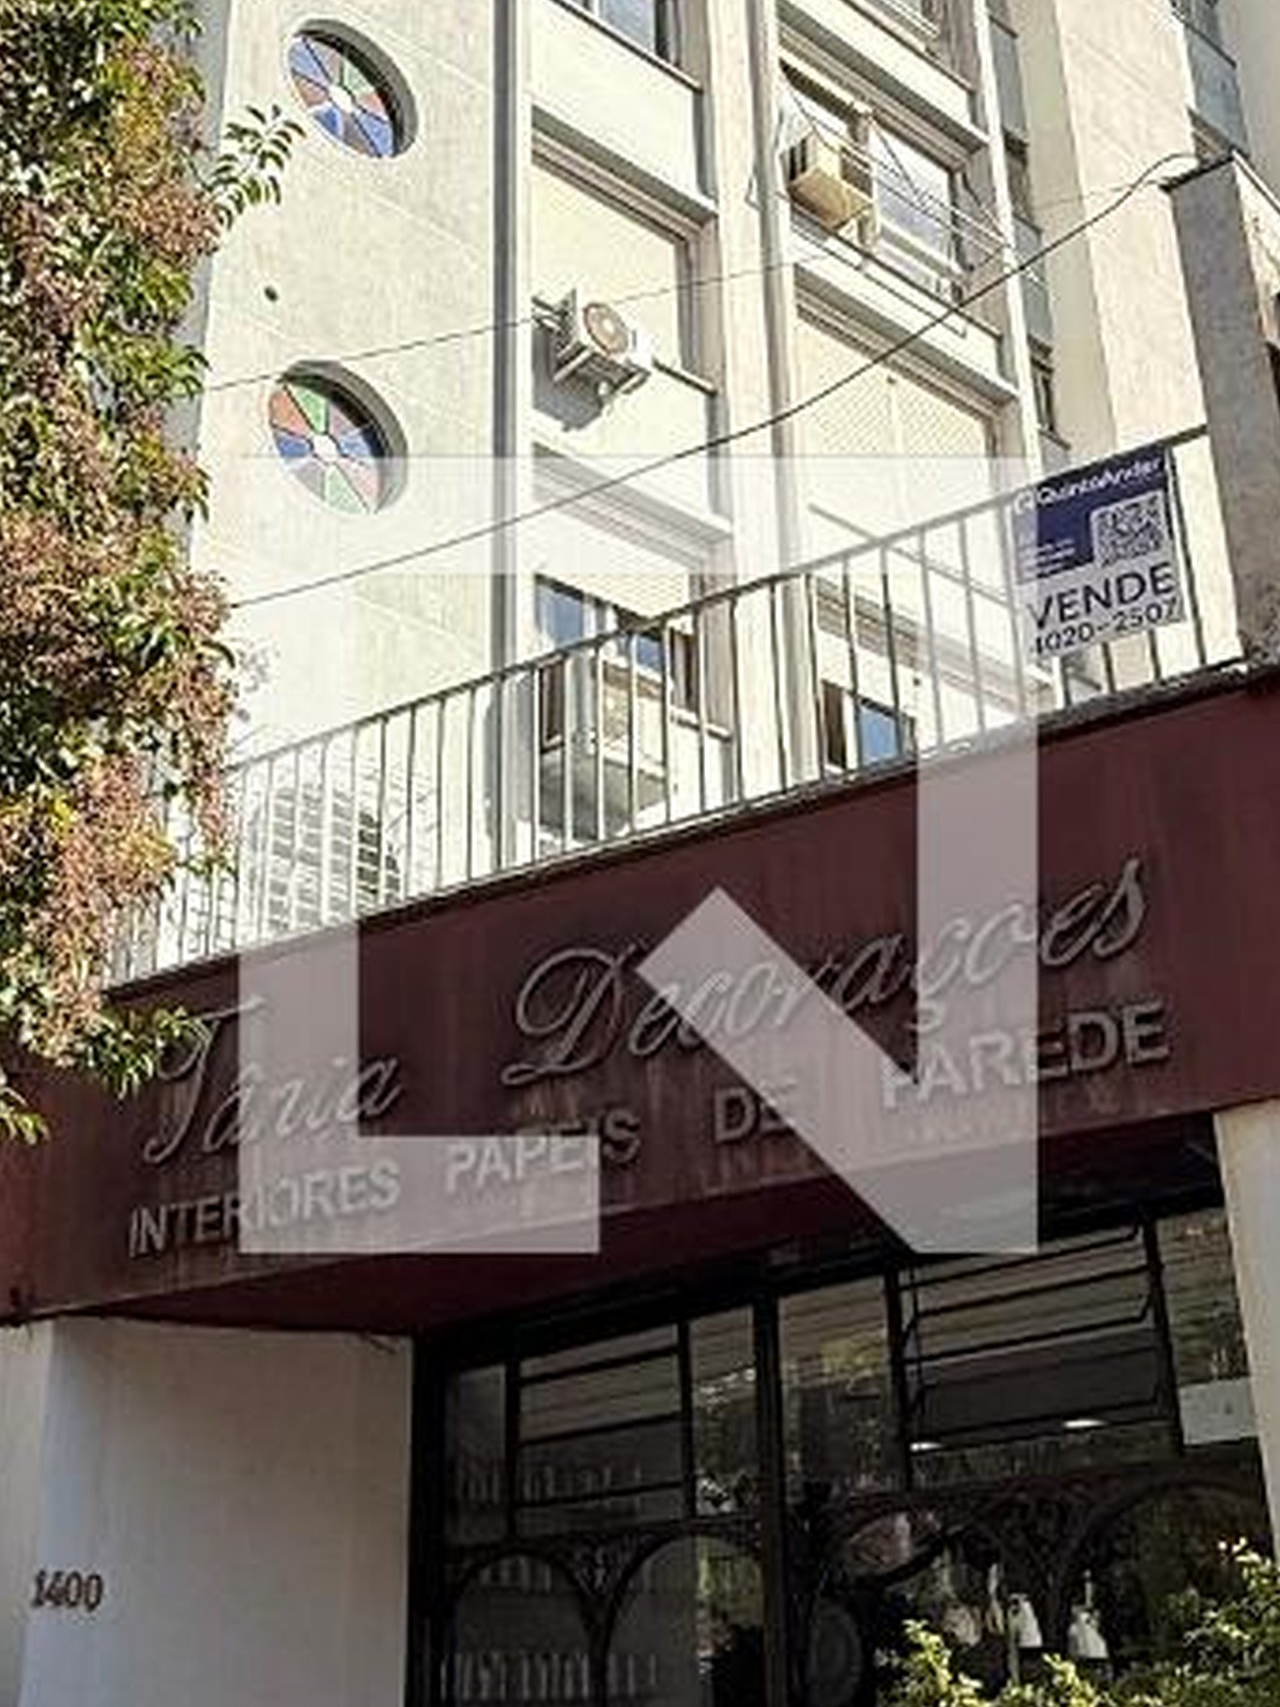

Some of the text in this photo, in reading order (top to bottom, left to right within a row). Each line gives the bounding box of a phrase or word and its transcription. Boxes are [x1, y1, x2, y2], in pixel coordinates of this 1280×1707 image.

[1026, 561, 1176, 630] VENDE
[129, 1158, 402, 1258] INTERIORES
[448, 1109, 641, 1192] PAPEIS
[31, 1568, 104, 1613] 1400
